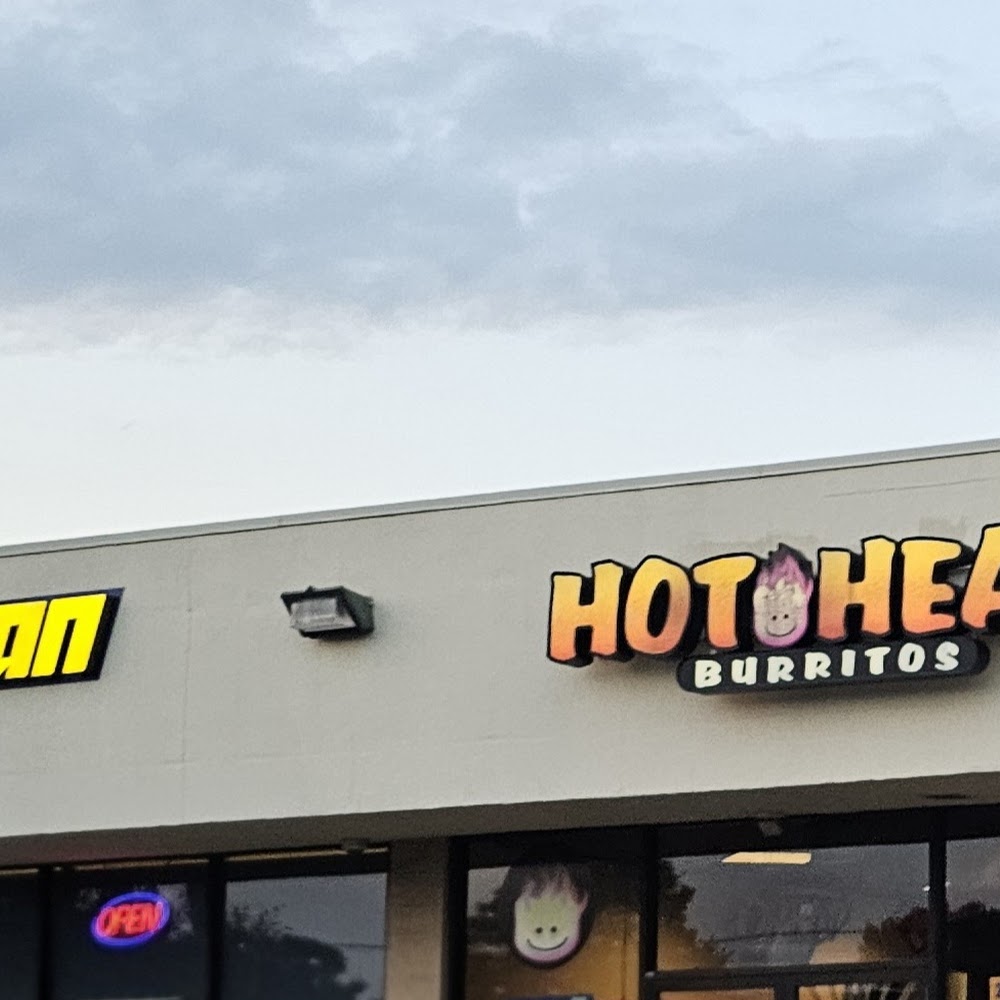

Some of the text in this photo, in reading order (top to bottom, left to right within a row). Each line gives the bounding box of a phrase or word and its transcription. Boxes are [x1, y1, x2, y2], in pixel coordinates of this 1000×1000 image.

[546, 554, 757, 665] HOT
[693, 640, 962, 690] BURRITOS
[97, 901, 164, 937] OPEN
